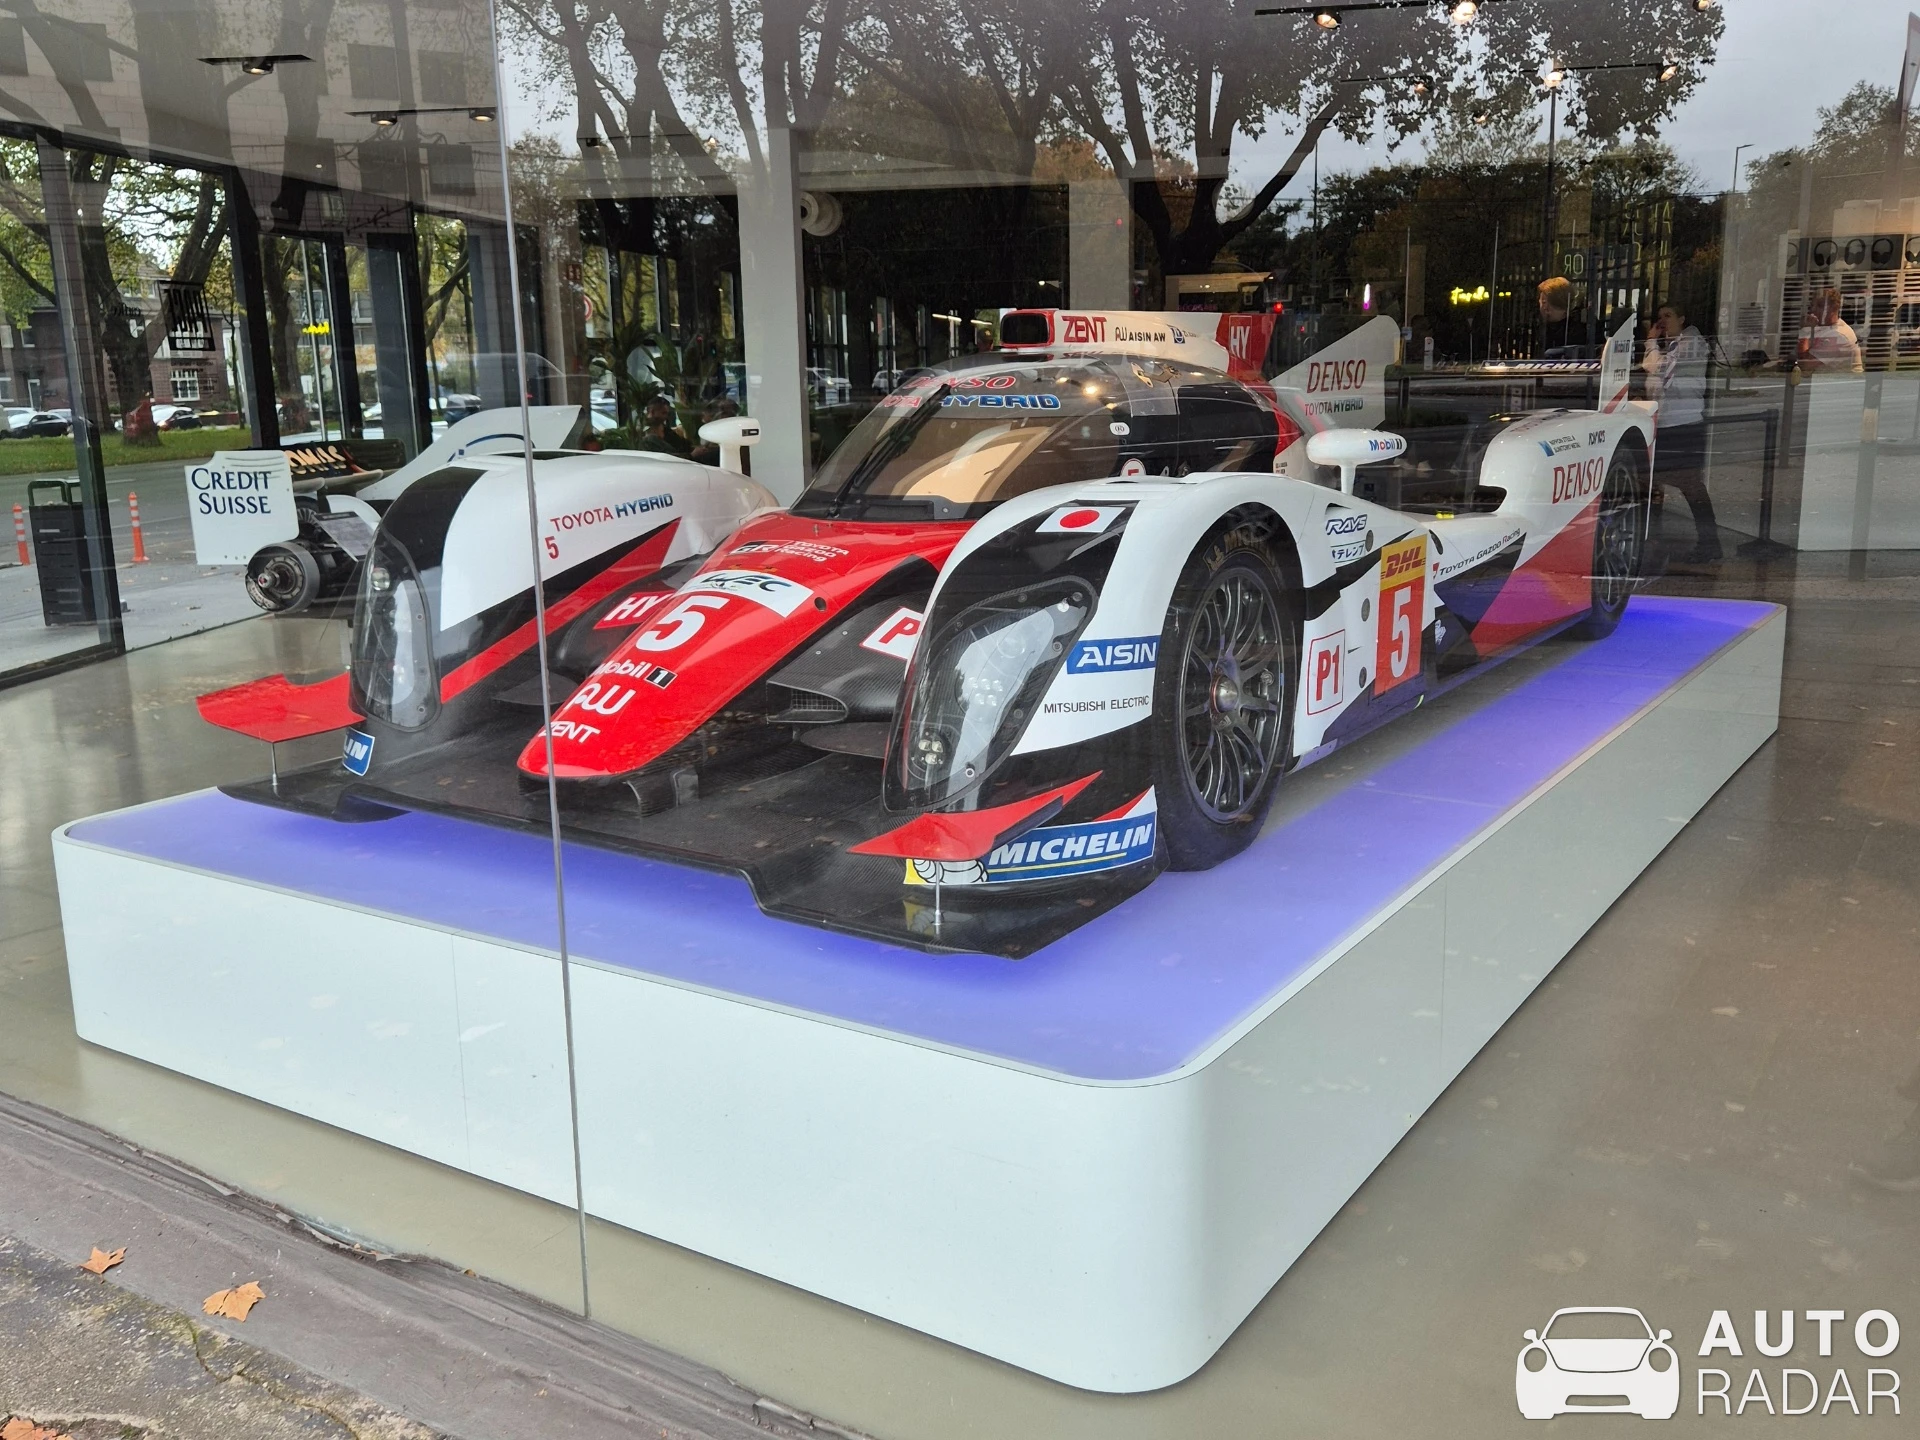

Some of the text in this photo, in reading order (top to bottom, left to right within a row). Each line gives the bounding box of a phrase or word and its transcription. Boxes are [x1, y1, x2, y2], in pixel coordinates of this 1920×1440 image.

[1062, 315, 1107, 343] ZENT
[1129, 331, 1151, 342] AISIN
[1154, 332, 1166, 342] AW
[1230, 325, 1251, 359] HY
[1307, 359, 1367, 393] DENSO
[939, 394, 1061, 410] HYBRID
[1305, 398, 1364, 416] TOYOTA HYBRID
[1369, 439, 1396, 451] Mobil
[191, 467, 272, 491] CREDIT
[1552, 457, 1604, 504] DENSO
[198, 492, 272, 515] SUISSE
[550, 493, 673, 532] TOYOTA HYBRID
[1325, 514, 1367, 535] RAYS
[545, 536, 559, 560] 5
[774, 548, 828, 562] Racing
[783, 544, 837, 558] GAZOO
[794, 540, 850, 555] TOYOTA
[1439, 527, 1521, 575] TOYOTA GAZOO Racing
[1384, 546, 1422, 579] DHL
[701, 572, 792, 592] WEC
[604, 593, 668, 622] HY
[635, 595, 731, 652] 5
[1390, 585, 1412, 678] 5
[1076, 642, 1157, 668] AISIN
[588, 659, 669, 684] Mobil 1
[1316, 644, 1341, 701] P1
[1044, 695, 1150, 714] MITSUBISHI ELECTRIC
[538, 720, 601, 744] ZENT
[988, 823, 1152, 866] MICHELIN
